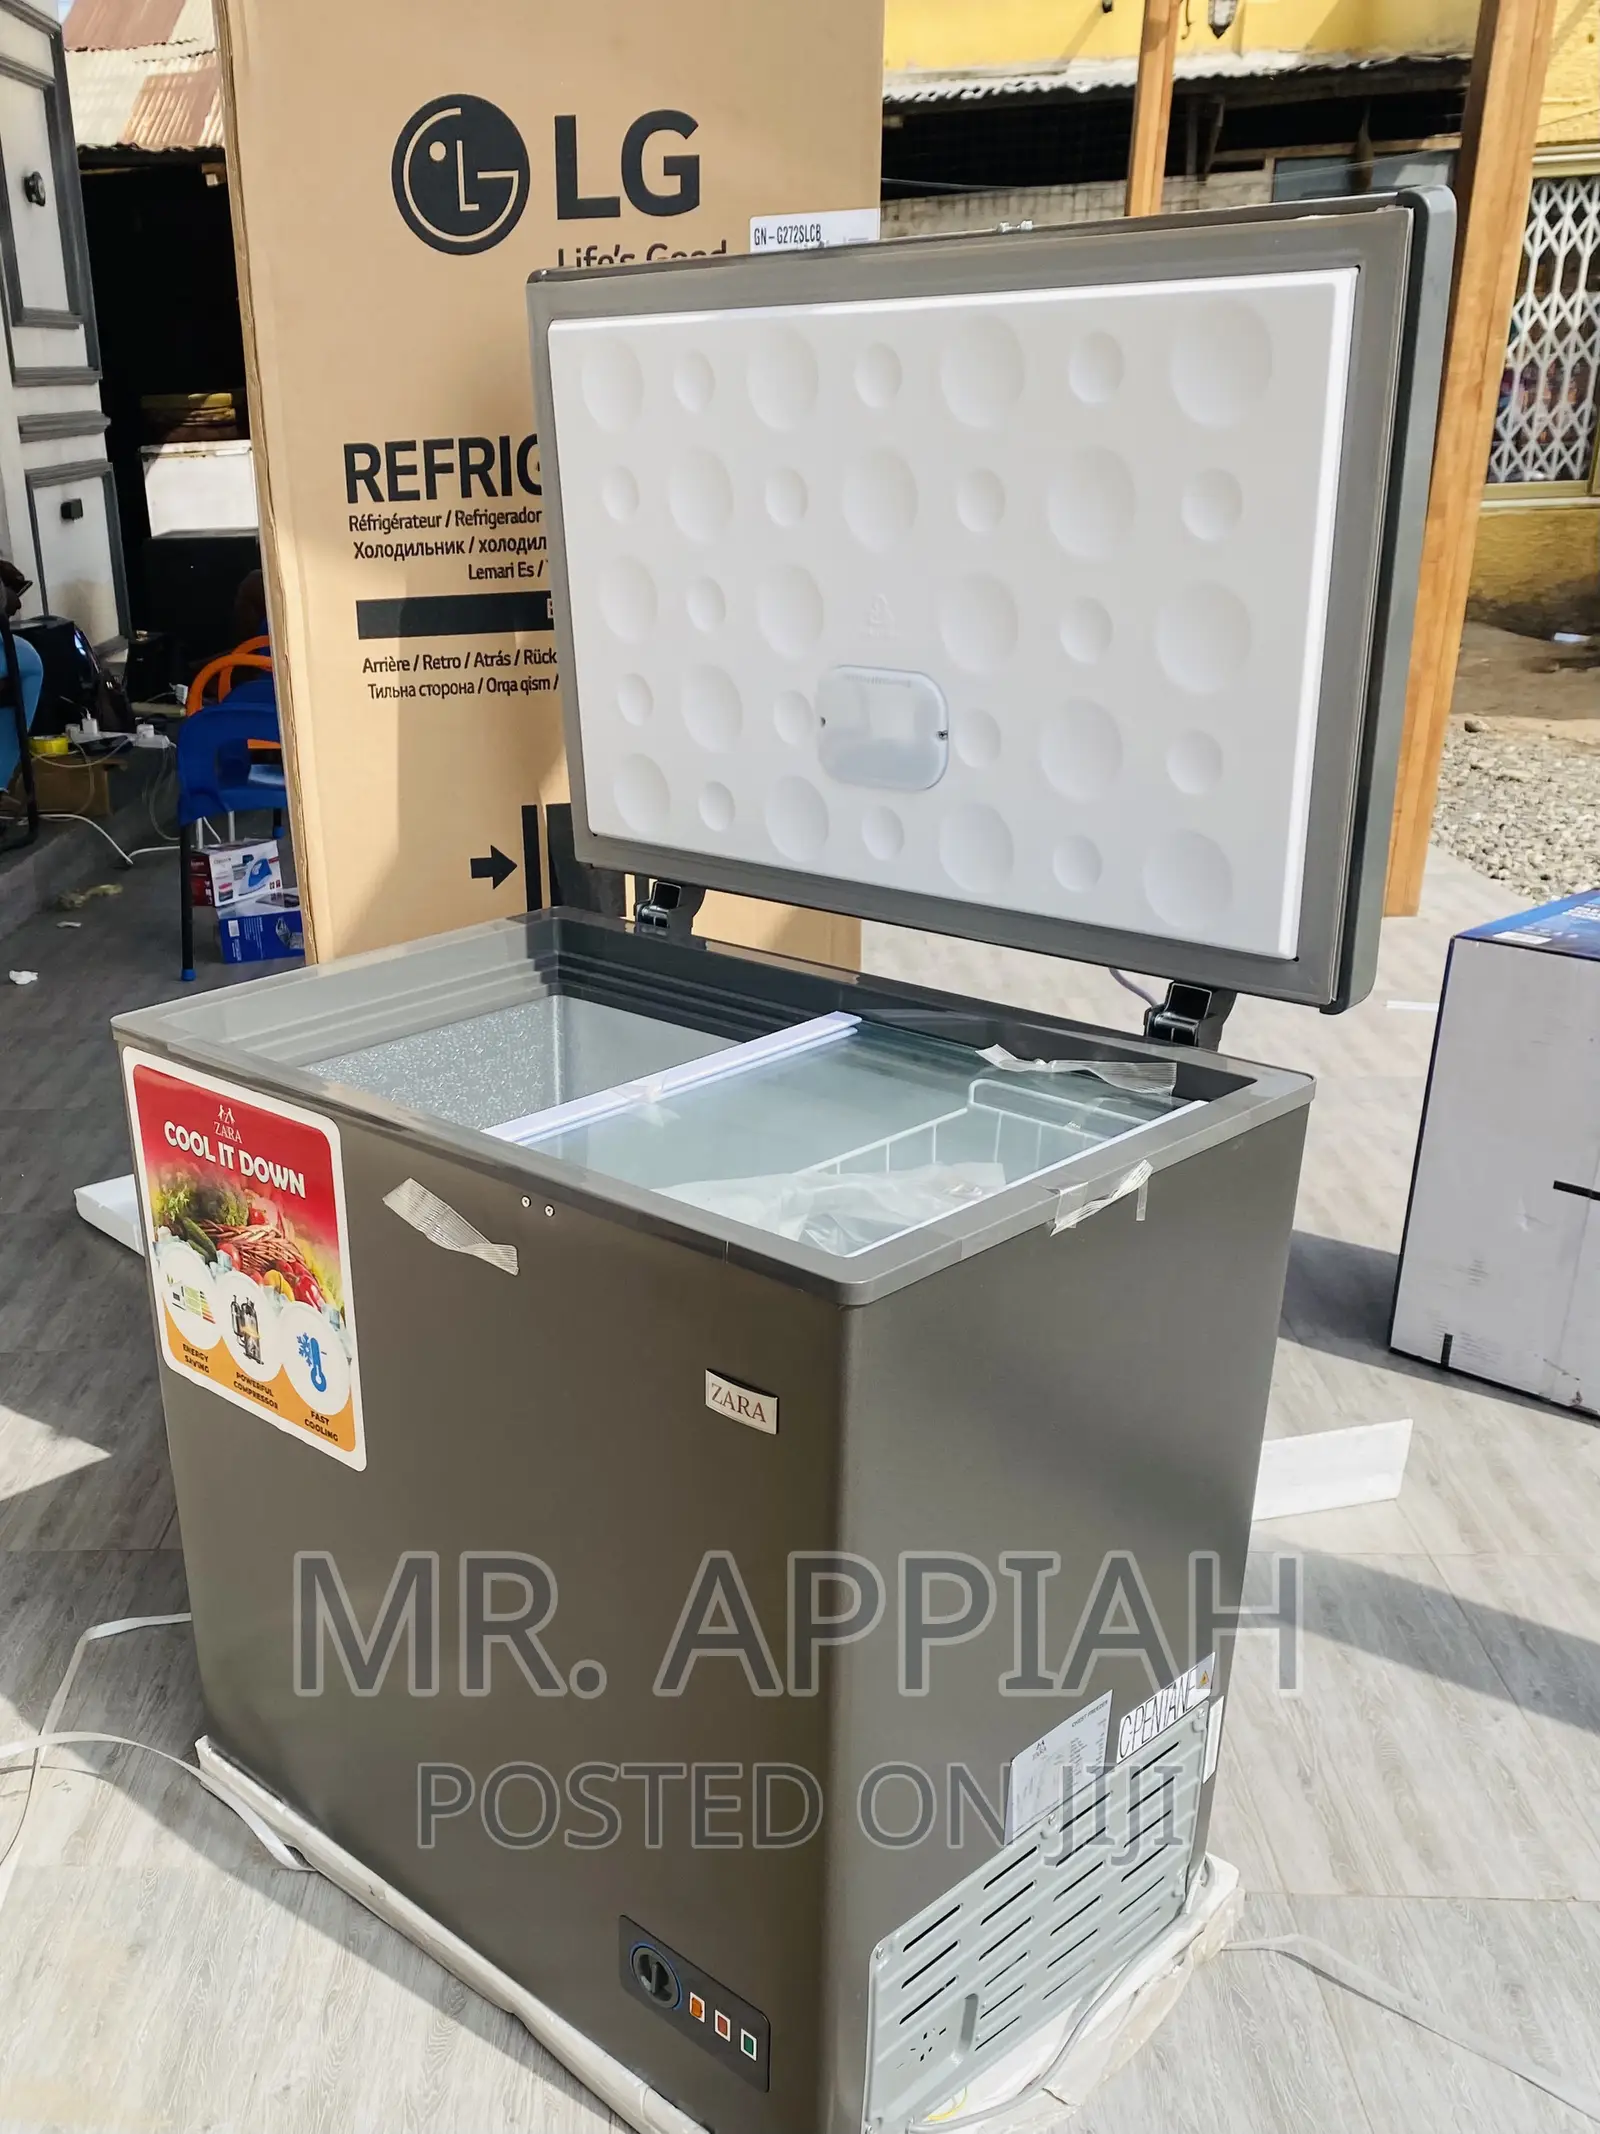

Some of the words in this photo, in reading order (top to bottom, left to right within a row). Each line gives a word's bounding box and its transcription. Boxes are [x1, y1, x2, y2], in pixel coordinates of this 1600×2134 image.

[554, 109, 700, 220] LG
[348, 512, 443, 535] Réfrigérateur
[455, 506, 543, 530] Refrigerador
[353, 539, 466, 561] Холодильник
[468, 562, 514, 580] Lemari
[517, 561, 535, 578] Es
[362, 656, 411, 673] Arrière
[423, 653, 462, 670] Retro
[474, 650, 511, 668] Atrás
[523, 647, 558, 665] Rück
[368, 682, 416, 700] Тильна
[419, 681, 475, 699] сторона
[486, 677, 518, 696] Orqa
[520, 674, 551, 696] qism
[213, 1121, 243, 1144] ZARA
[163, 1120, 216, 1163] COOL
[217, 1140, 235, 1170] IT
[238, 1149, 307, 1199] DOWN
[182, 1343, 209, 1363] ENERGY
[233, 1380, 279, 1410] COMPRESSOR
[236, 1371, 275, 1398] POWERFUL
[711, 1382, 767, 1424] ZARA
[304, 1418, 339, 1442] COOLING
[310, 1410, 330, 1426] FAST
